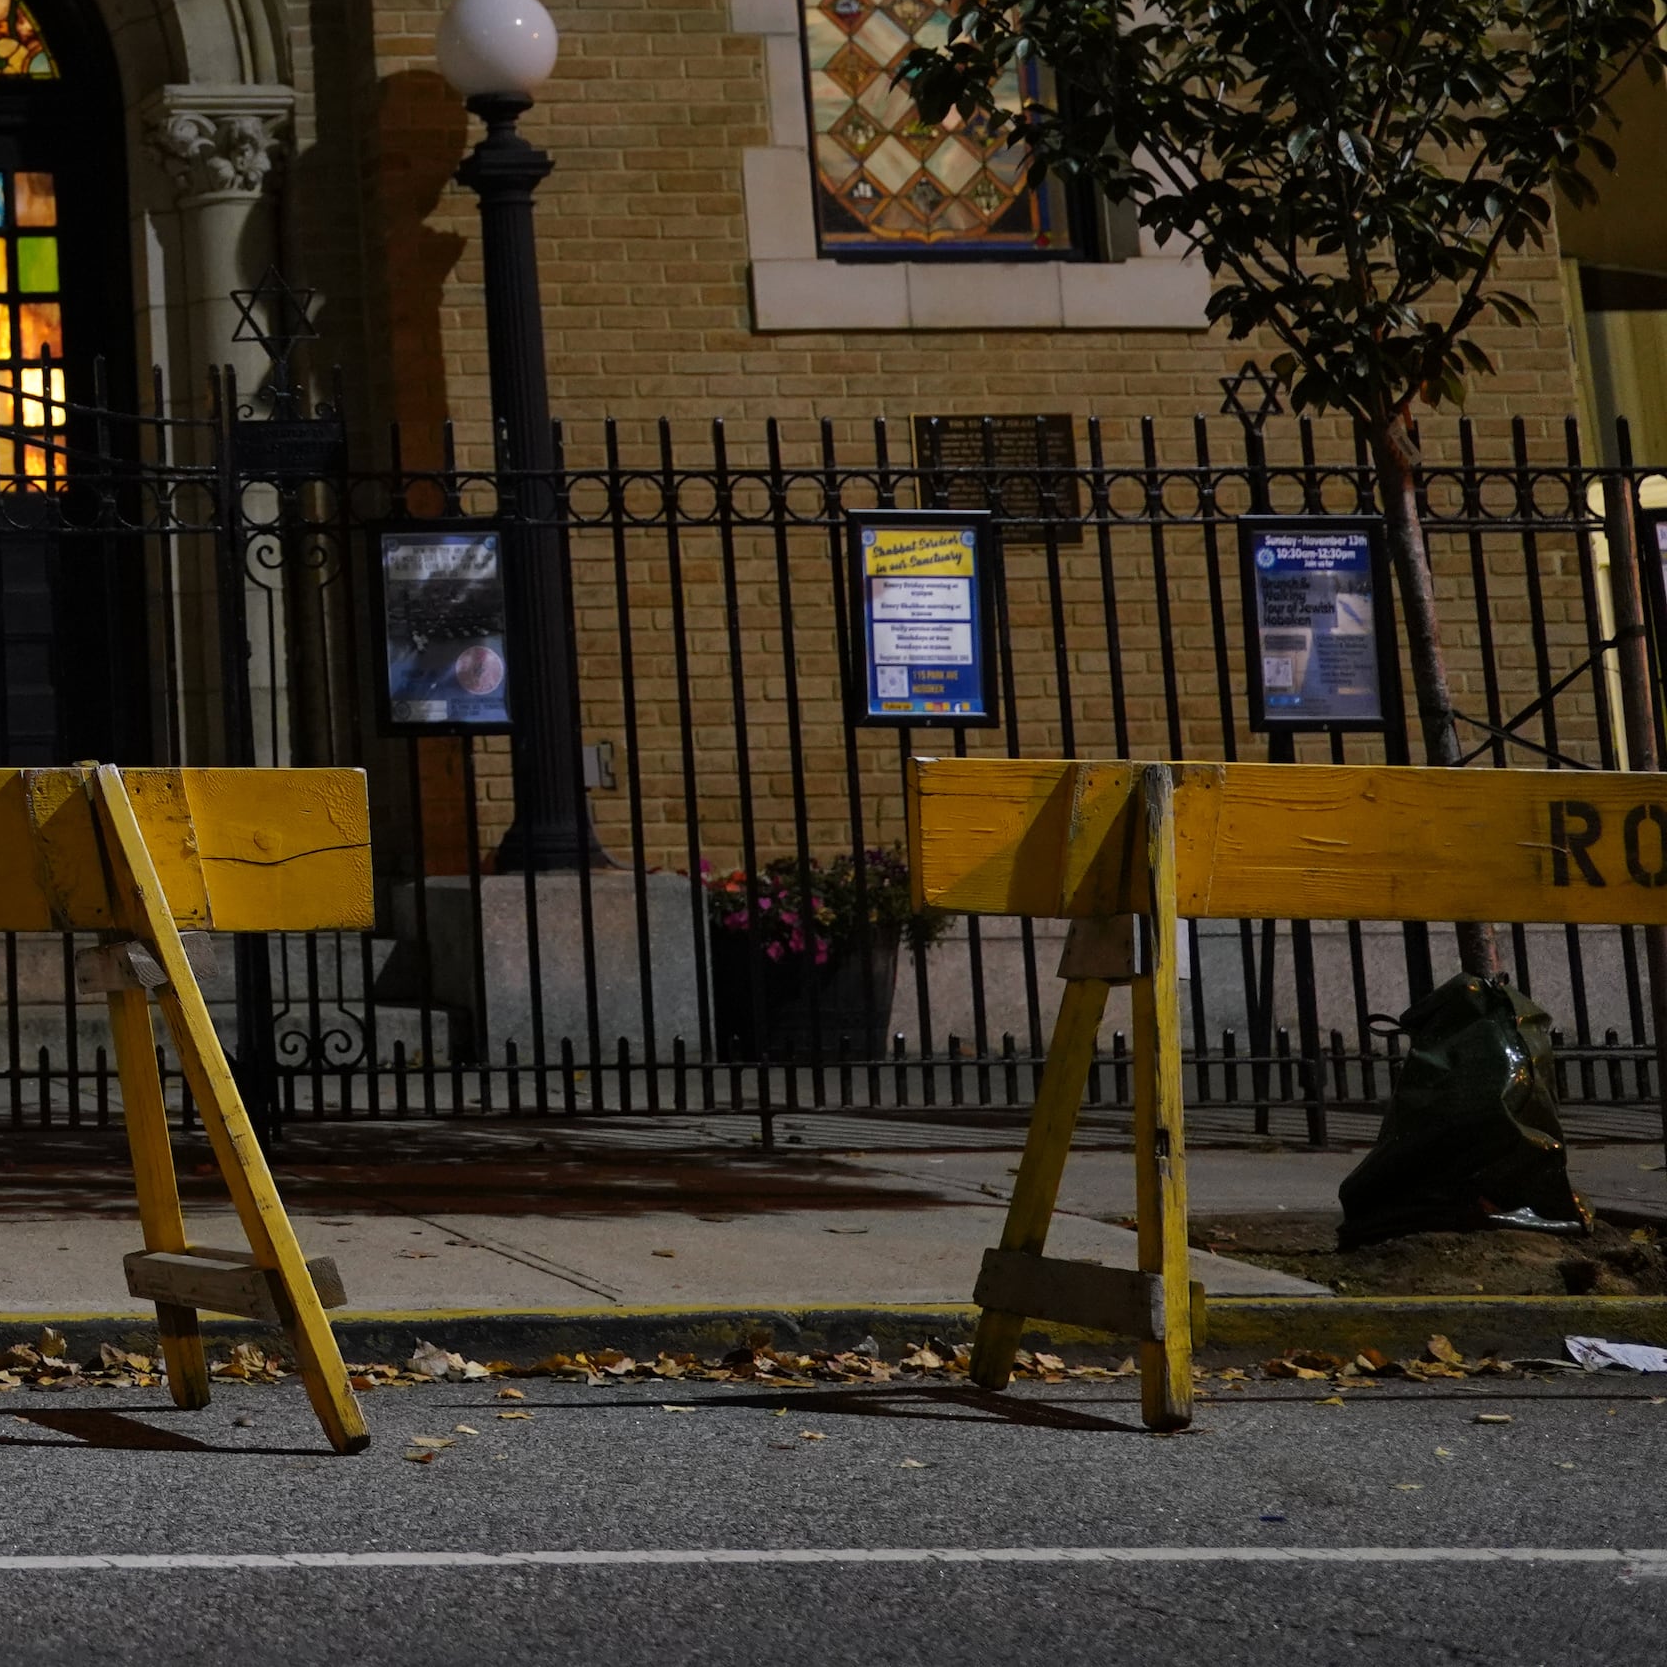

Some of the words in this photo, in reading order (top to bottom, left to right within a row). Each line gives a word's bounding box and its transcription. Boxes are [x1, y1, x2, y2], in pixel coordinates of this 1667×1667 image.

[872, 540, 916, 558] Shabbat
[918, 534, 958, 550] Services
[1265, 535, 1297, 547] Sunday
[1302, 535, 1347, 546] November
[1348, 535, 1368, 546] 13th
[910, 551, 963, 567] Sanctuary
[1548, 799, 1667, 889] RO
